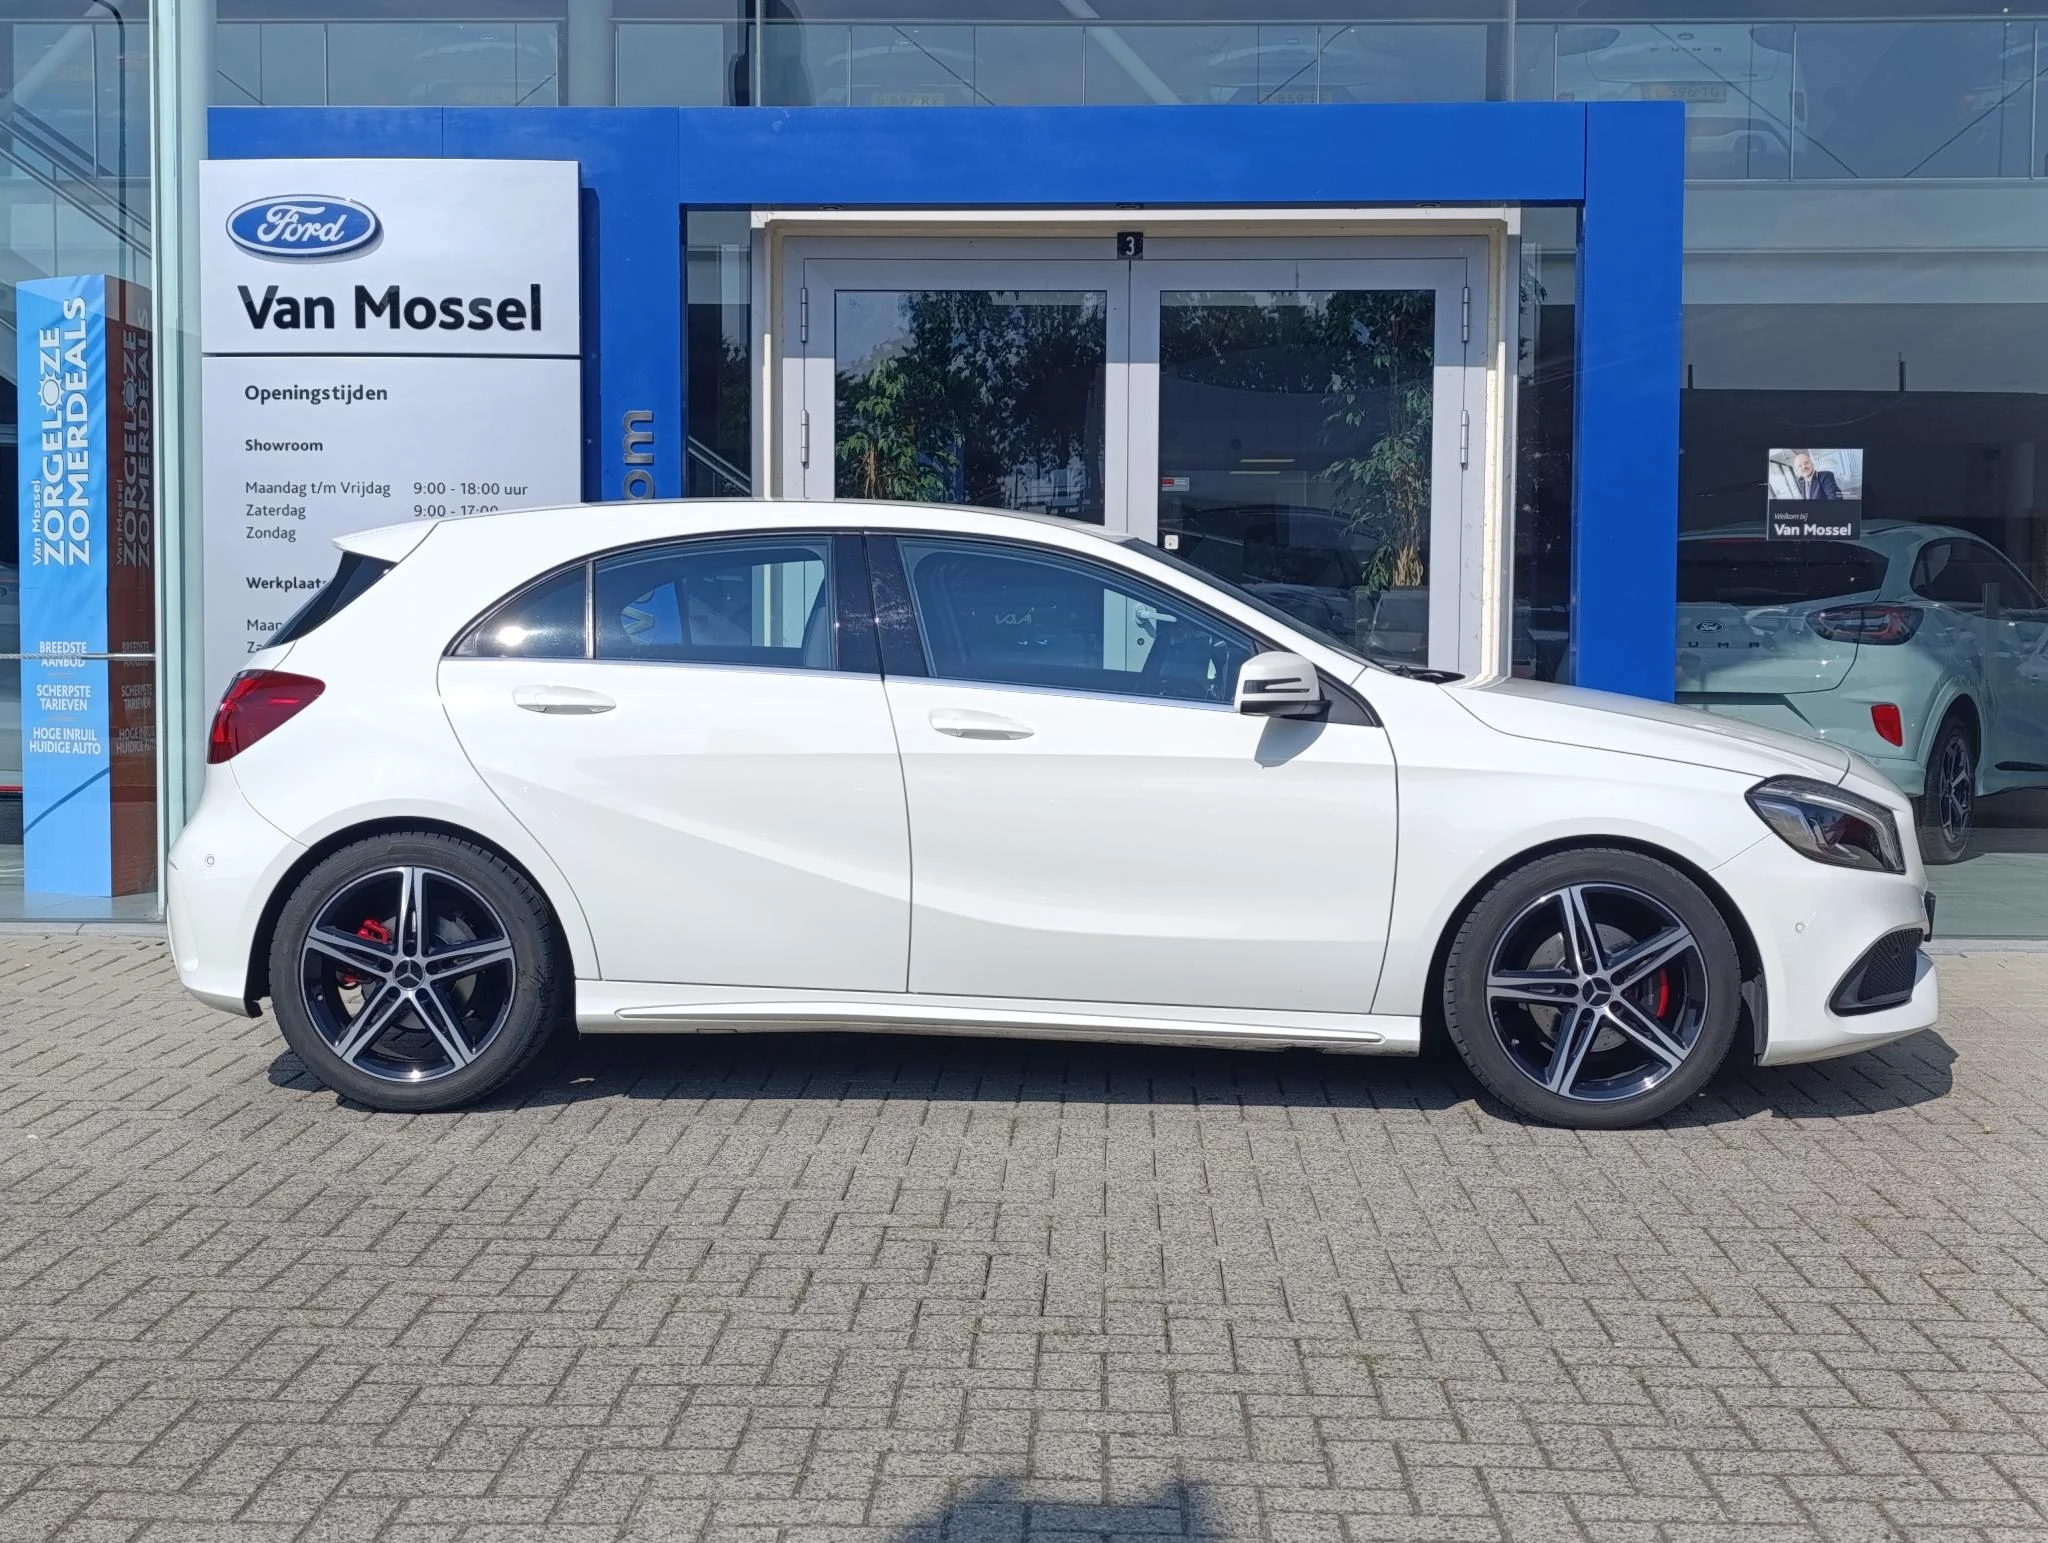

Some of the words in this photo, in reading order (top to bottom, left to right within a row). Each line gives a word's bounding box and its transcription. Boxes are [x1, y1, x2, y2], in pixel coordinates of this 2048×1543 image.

[257, 204, 347, 243] Ford
[1126, 236, 1135, 256] 3
[237, 285, 335, 330] Van
[355, 283, 542, 331] Mossel
[245, 384, 388, 405] Openingstijden
[63, 297, 90, 567] ZOMERDEALS
[245, 438, 324, 451] Showroom
[245, 481, 307, 498] Maandag
[311, 481, 336, 494] t/m
[340, 481, 391, 498] Vrijdag
[413, 482, 446, 495] 9:00
[460, 482, 500, 495] 18:00
[504, 486, 528, 495] uur
[32, 479, 42, 533] Mossel
[246, 504, 306, 520] Zaterdag
[413, 504, 446, 517] 9:00
[246, 526, 297, 542] Zondag
[1774, 523, 1800, 536] Van
[1803, 523, 1852, 536] Mossel
[32, 538, 42, 566] Van
[1699, 622, 1721, 631] Ford
[40, 641, 87, 653] BREEDSTE
[36, 684, 91, 698] SCHERPSTE
[40, 698, 87, 711] TARIEVEN
[33, 727, 62, 740] HOGE
[63, 728, 97, 741] INRUIL
[29, 740, 71, 754] HUIDIGE
[73, 742, 101, 755] AUTO
